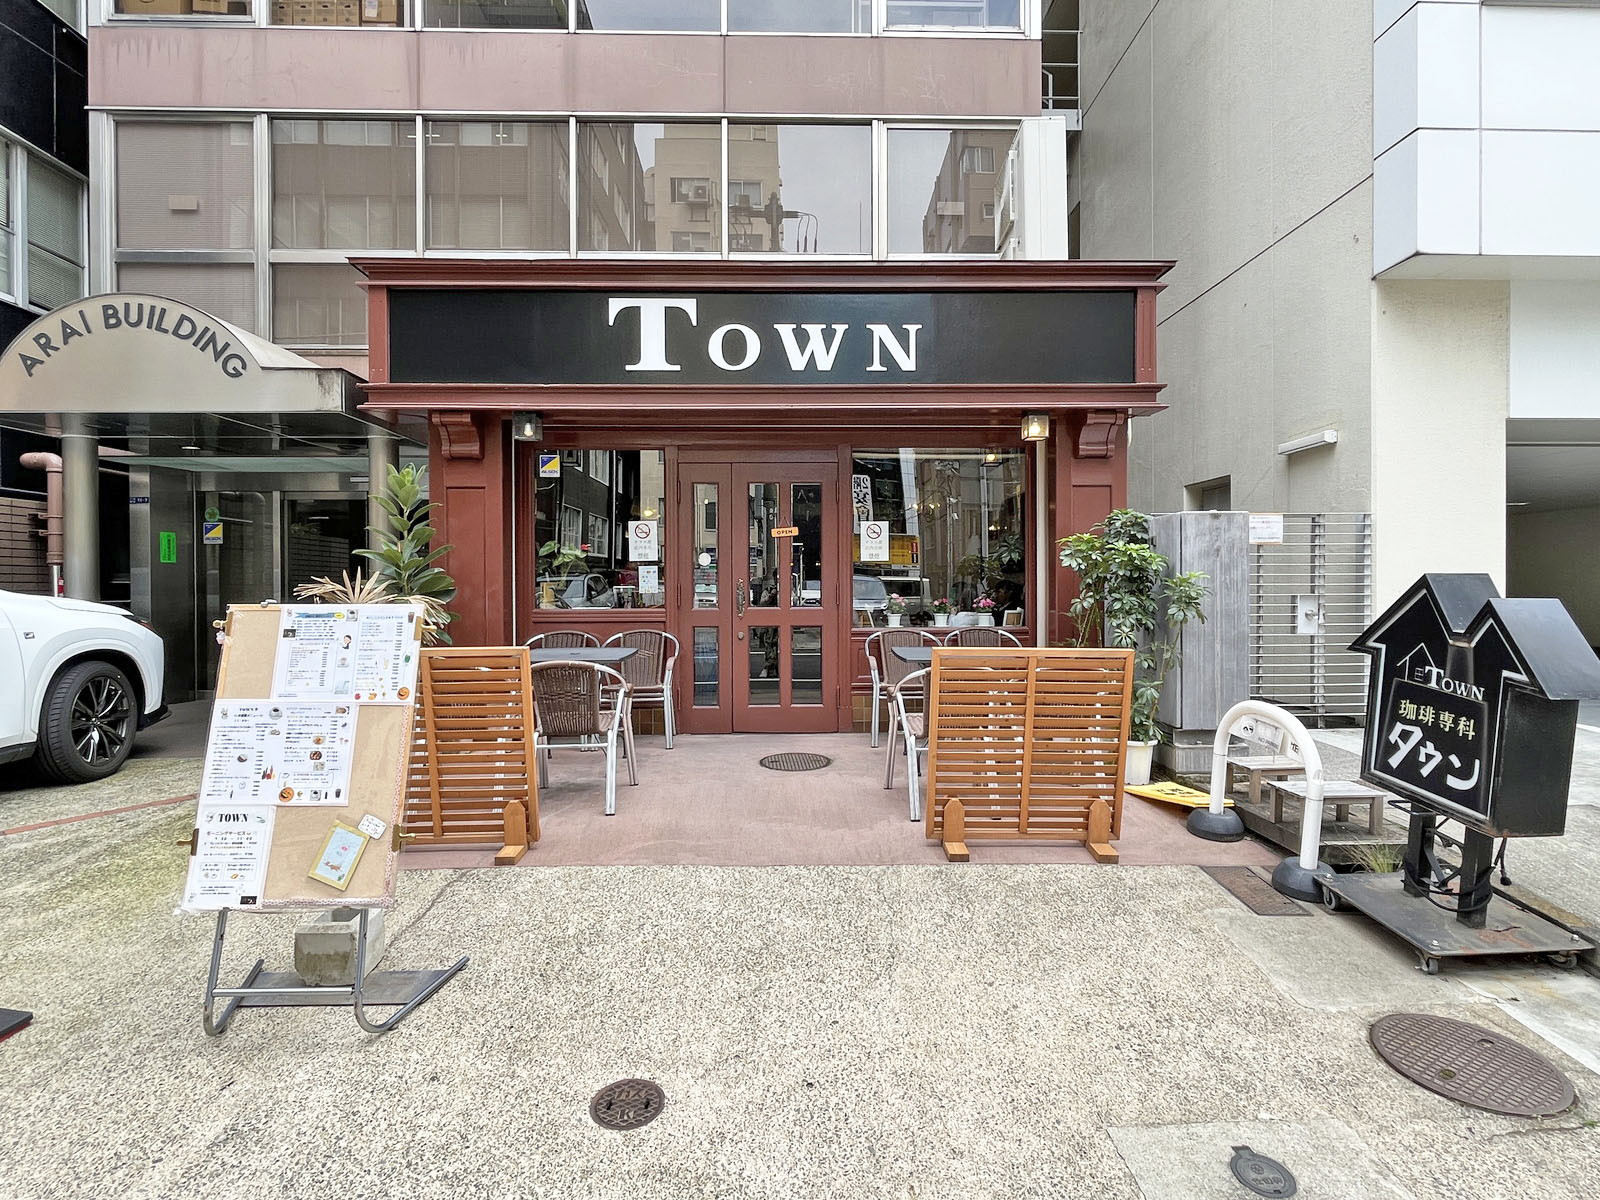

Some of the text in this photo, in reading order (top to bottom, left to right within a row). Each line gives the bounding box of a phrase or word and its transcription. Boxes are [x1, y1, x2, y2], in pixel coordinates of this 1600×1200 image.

[18, 302, 247, 378] ARAI BUILDING
[608, 297, 923, 371] TOWN
[1425, 665, 1485, 701] TOWN
[1398, 699, 1476, 741] 珈琲専科
[1387, 721, 1480, 791] タウン
[218, 813, 249, 823] TOWN
